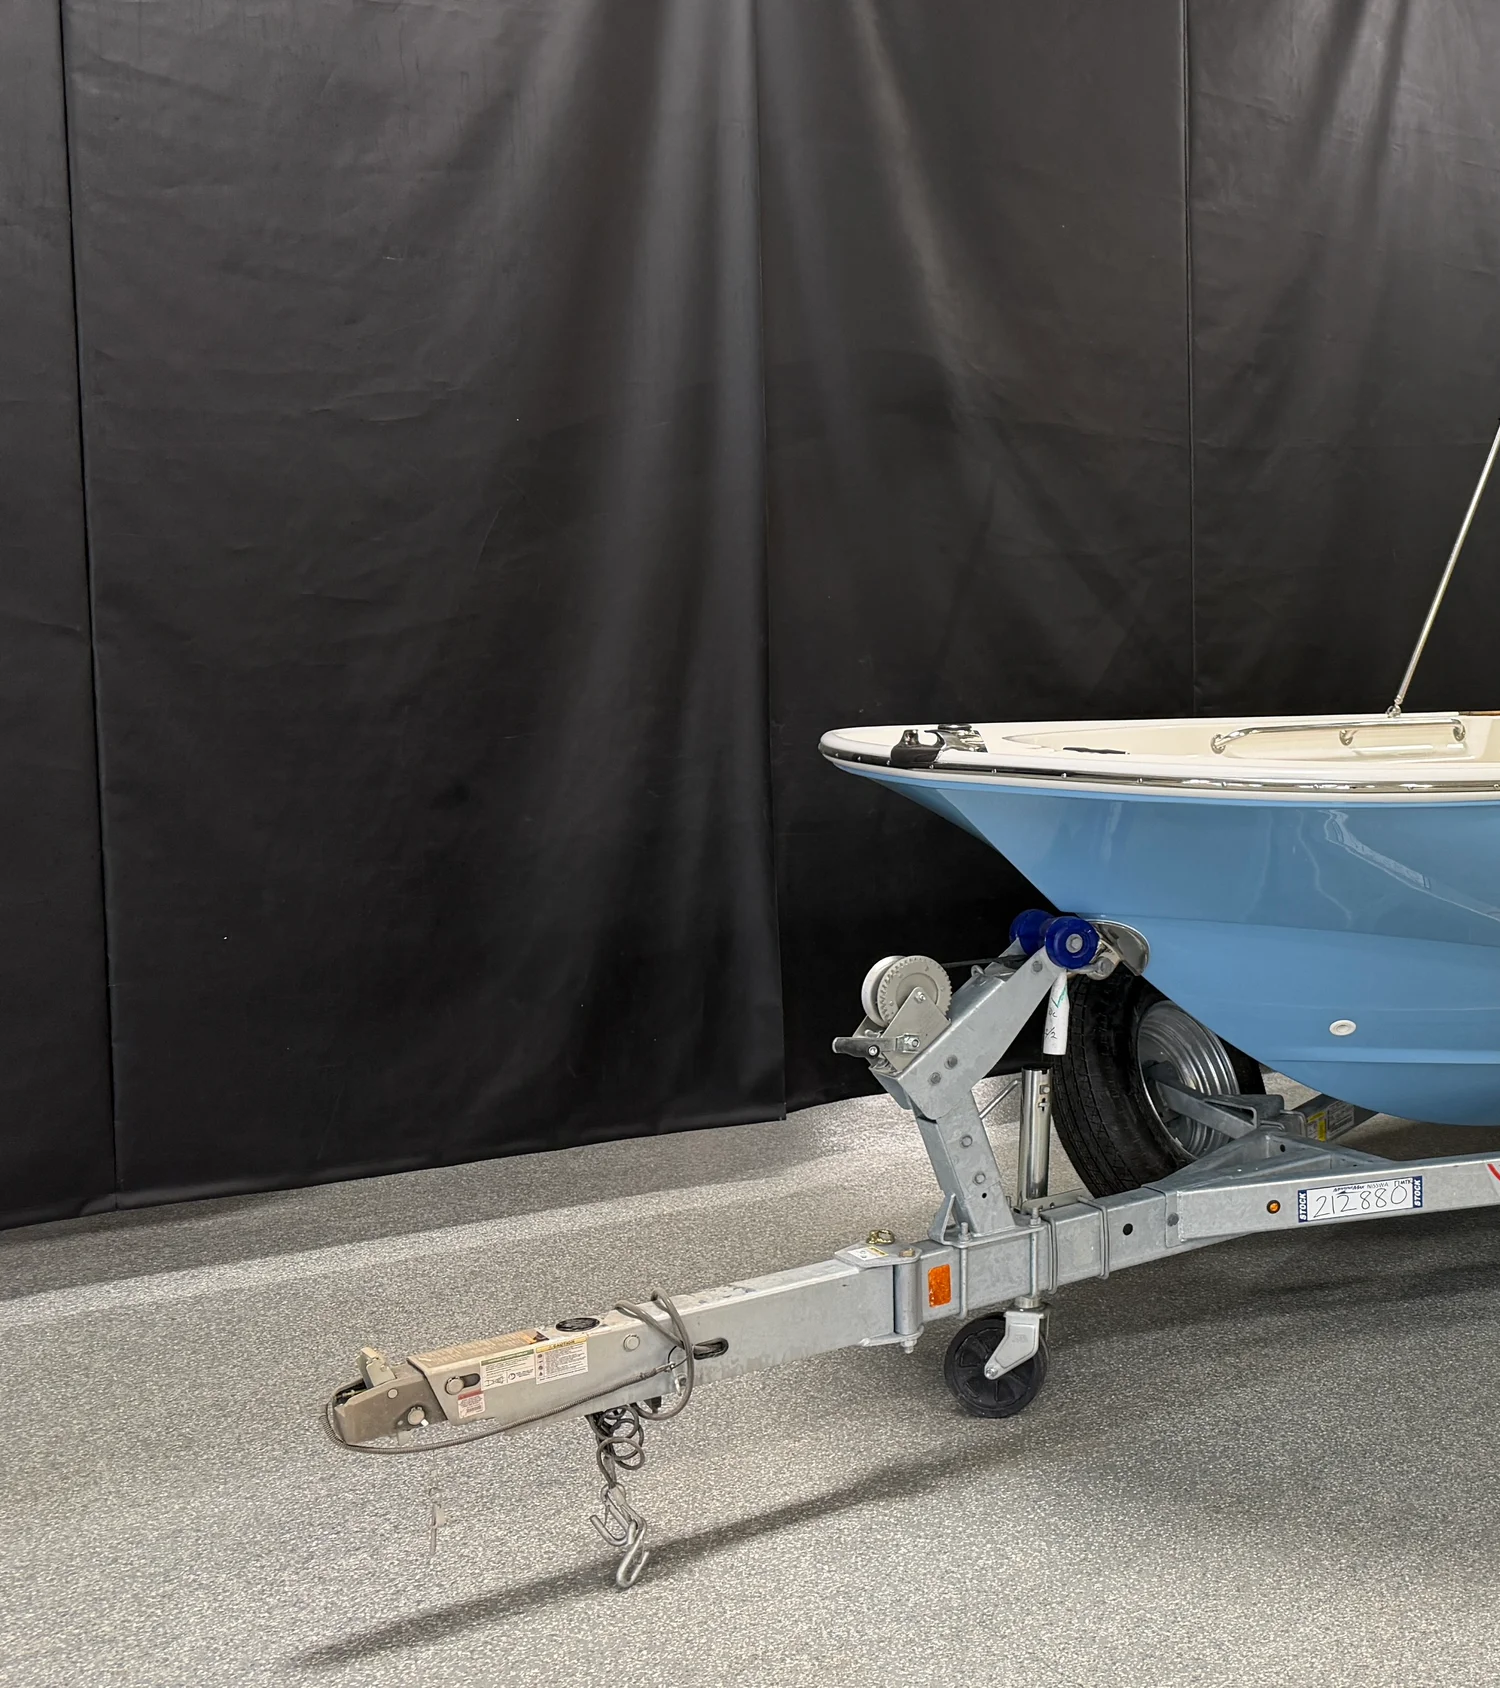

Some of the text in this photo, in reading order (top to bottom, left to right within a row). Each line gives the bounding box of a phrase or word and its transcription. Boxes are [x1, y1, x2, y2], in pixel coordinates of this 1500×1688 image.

[1299, 1193, 1307, 1221] STOCK
[1313, 1185, 1408, 1218] 212880
[1414, 1179, 1422, 1207] STOCK
